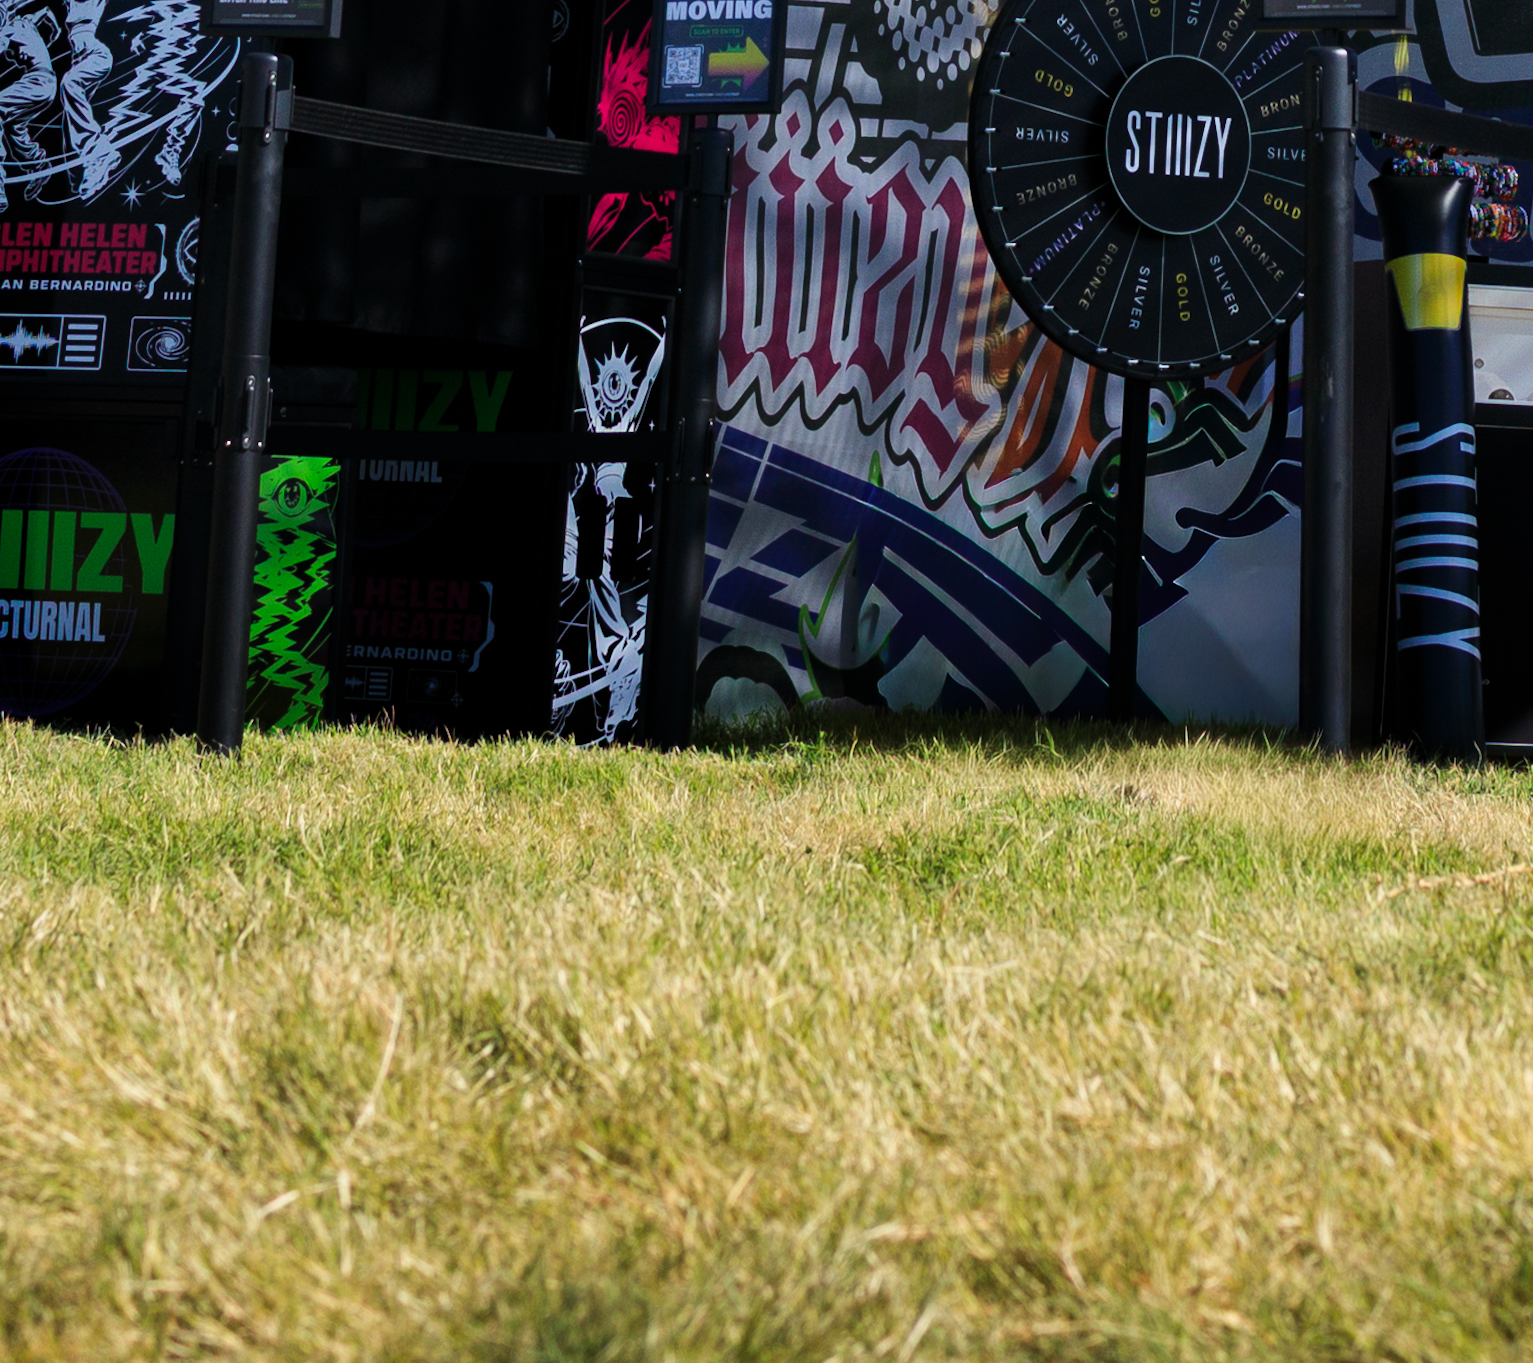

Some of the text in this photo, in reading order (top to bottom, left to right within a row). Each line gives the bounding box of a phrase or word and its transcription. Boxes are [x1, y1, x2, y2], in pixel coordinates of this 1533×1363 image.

[665, 0, 773, 21] MOVING
[1056, 12, 1100, 66] SILVER
[1034, 68, 1075, 98] GOLD
[1259, 92, 1303, 119] BRON
[1014, 125, 1070, 143] SILVER
[1124, 109, 1233, 180] STIIIZY
[1266, 146, 1307, 162] SILVE
[1016, 173, 1078, 205] BRONZE
[1262, 191, 1302, 221] GOLD
[59, 222, 148, 249] HELEN
[1234, 224, 1285, 283] BRONZE
[29, 278, 132, 292] BERNARDINO
[1078, 242, 1119, 311] BRONZE
[1209, 254, 1240, 317] SILVER
[1129, 264, 1151, 331] SILVER
[1175, 272, 1191, 323] GOLD
